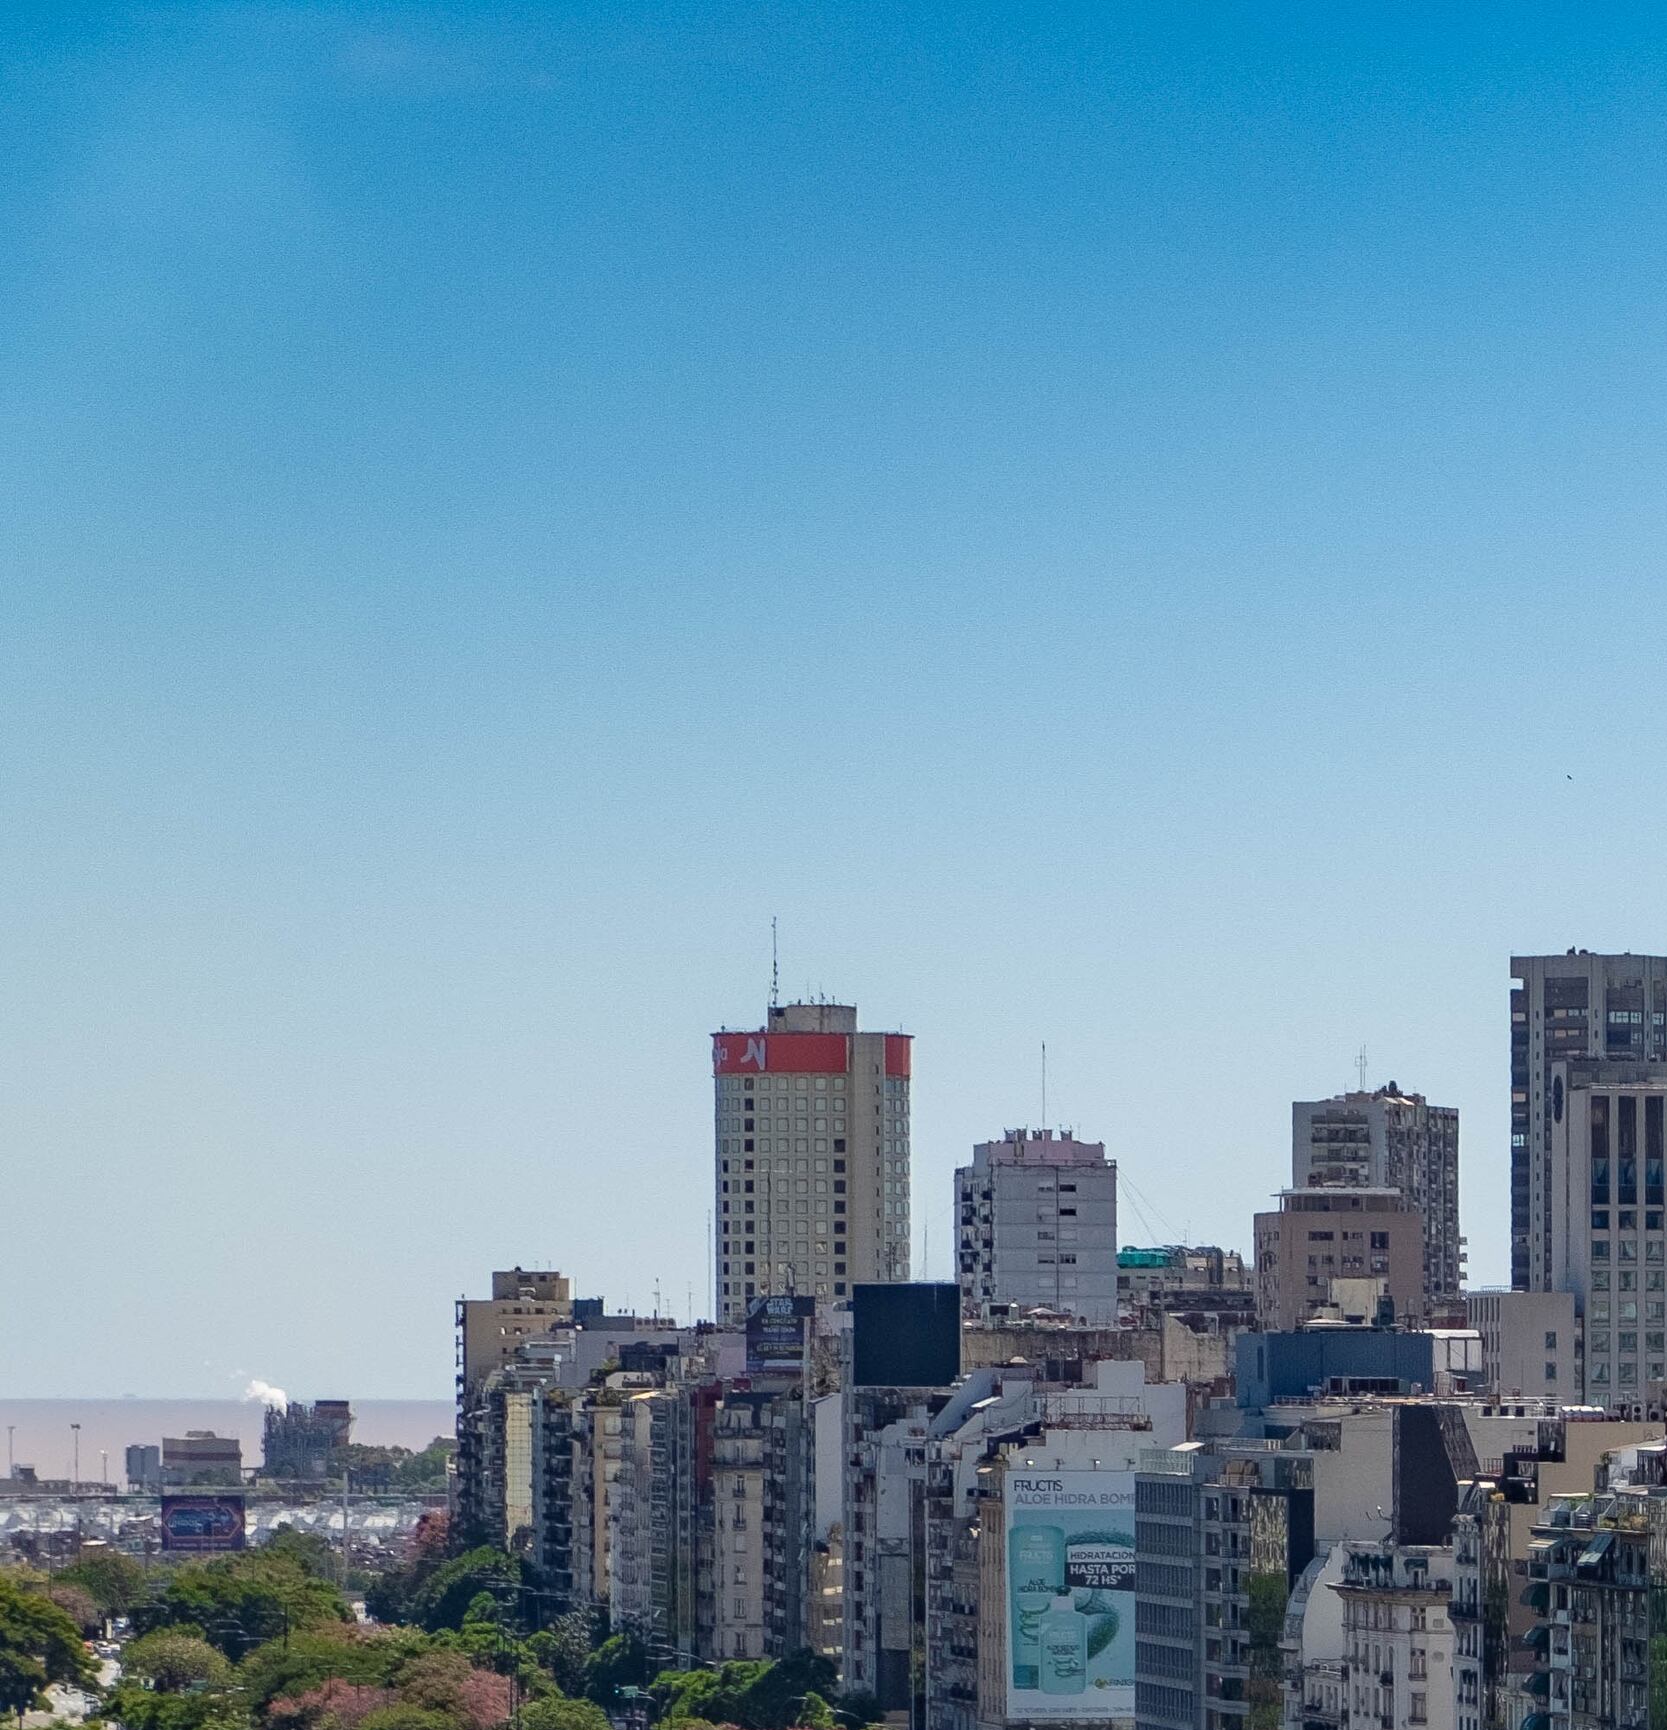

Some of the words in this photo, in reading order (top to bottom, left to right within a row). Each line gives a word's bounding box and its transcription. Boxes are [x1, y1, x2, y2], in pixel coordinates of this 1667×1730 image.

[1013, 1479, 1063, 1492] FRUCTIS
[1015, 1493, 1052, 1505] ALOE
[1054, 1493, 1097, 1505] HIDRA
[1069, 1564, 1108, 1575] HASTA
[1111, 1564, 1136, 1575] POR
[1085, 1575, 1100, 1585] 72
